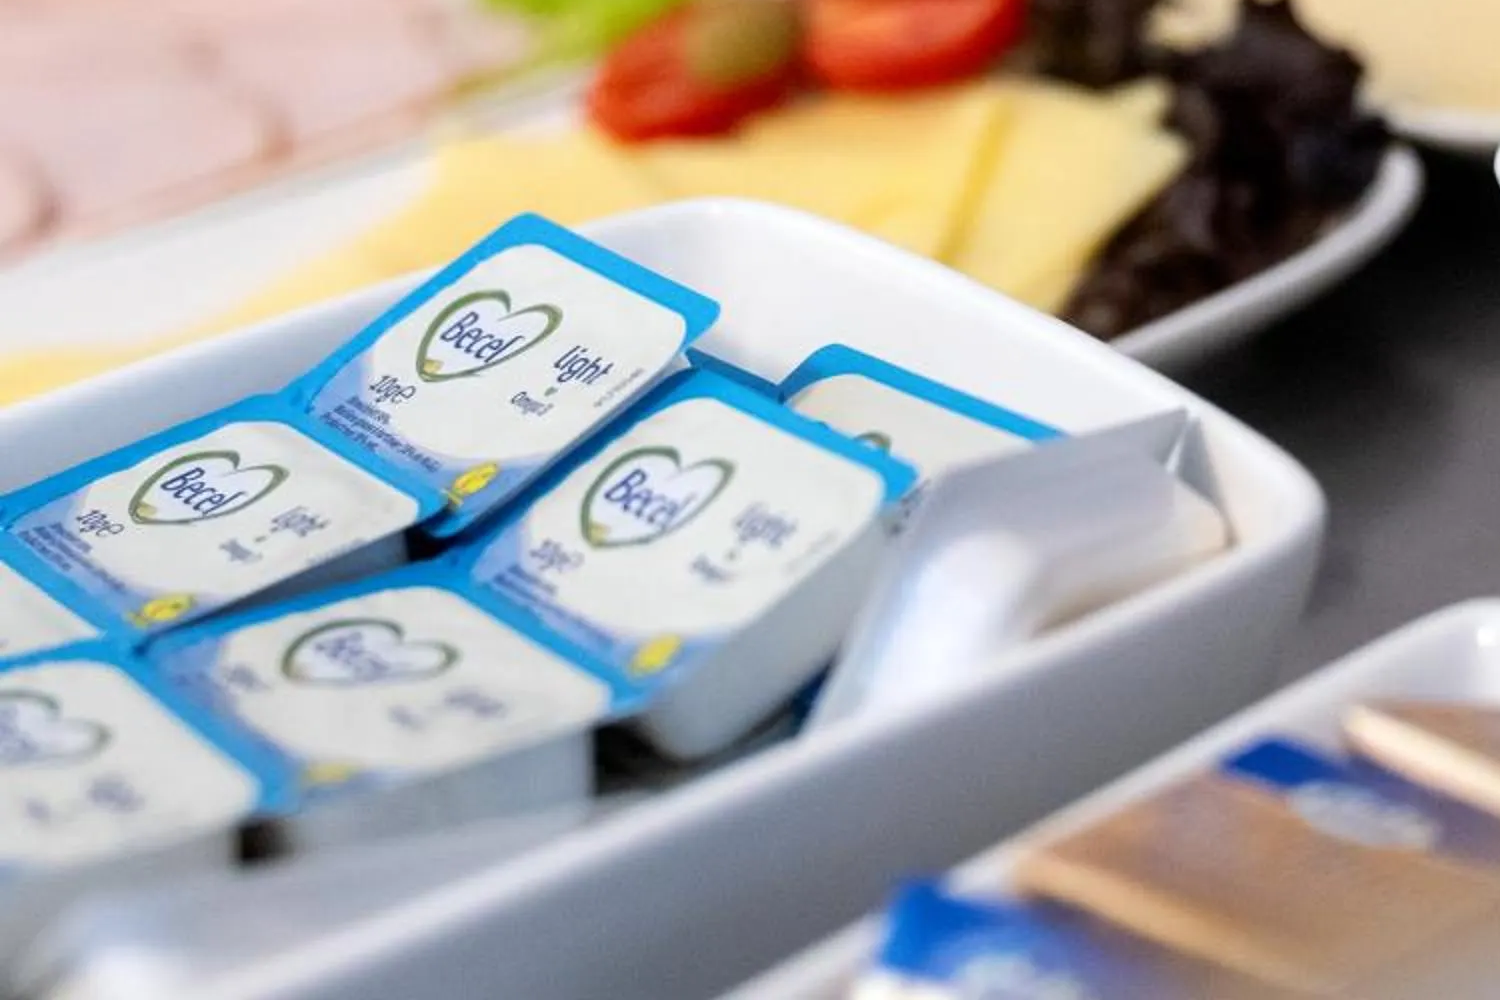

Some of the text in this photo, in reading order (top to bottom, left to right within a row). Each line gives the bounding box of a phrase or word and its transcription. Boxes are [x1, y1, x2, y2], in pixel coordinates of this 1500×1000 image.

[439, 311, 526, 364] Becel
[553, 344, 614, 386] light
[160, 466, 247, 519] Becel
[603, 467, 698, 529] Becel
